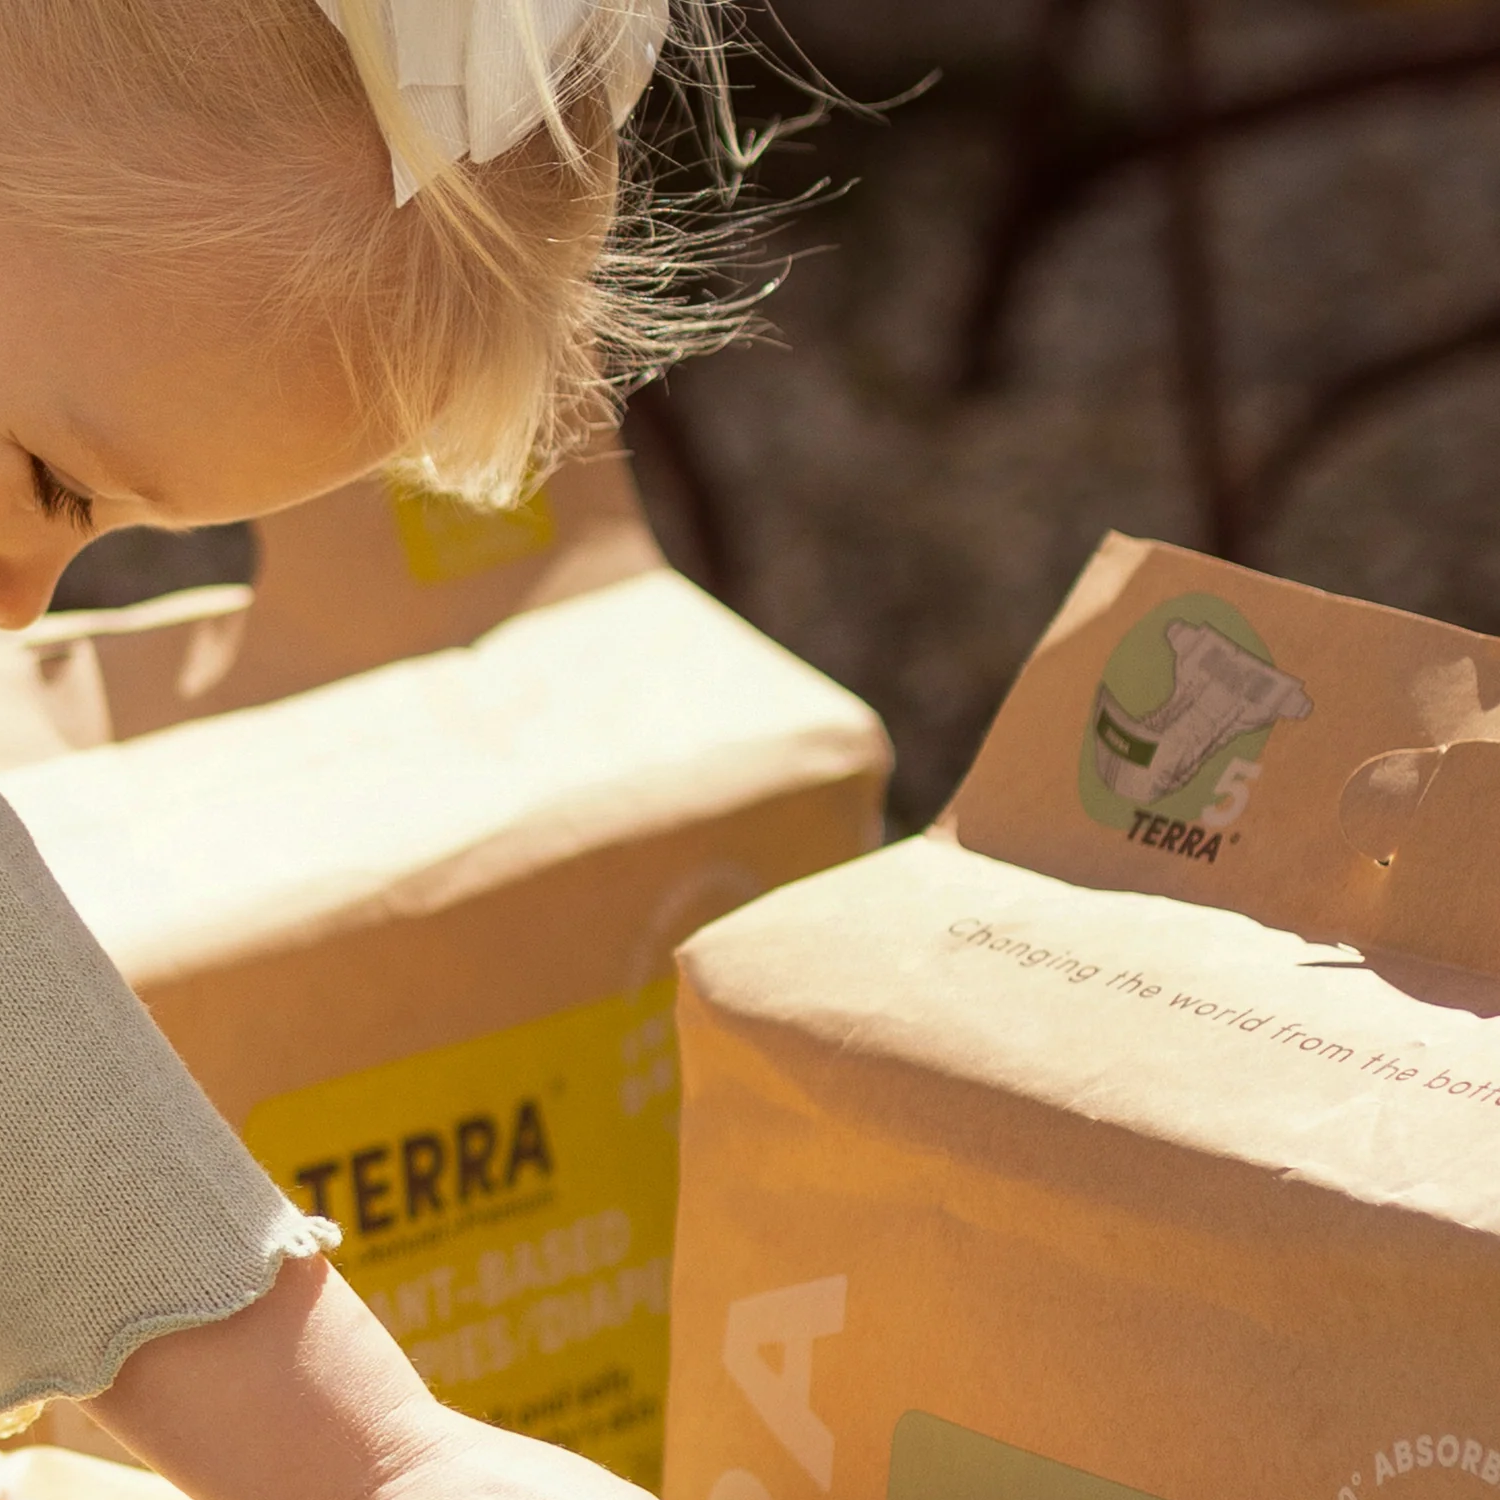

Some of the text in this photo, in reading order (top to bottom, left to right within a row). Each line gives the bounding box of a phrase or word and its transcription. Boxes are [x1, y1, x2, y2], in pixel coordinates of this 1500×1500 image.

[1127, 808, 1223, 864] TERRA
[1202, 757, 1263, 828] 5
[947, 917, 1102, 984] Changing
[1106, 969, 1163, 1002] the
[1169, 991, 1274, 1035] world
[1271, 1021, 1356, 1064] from
[1362, 1052, 1420, 1084] the
[295, 1095, 555, 1236] TERRA
